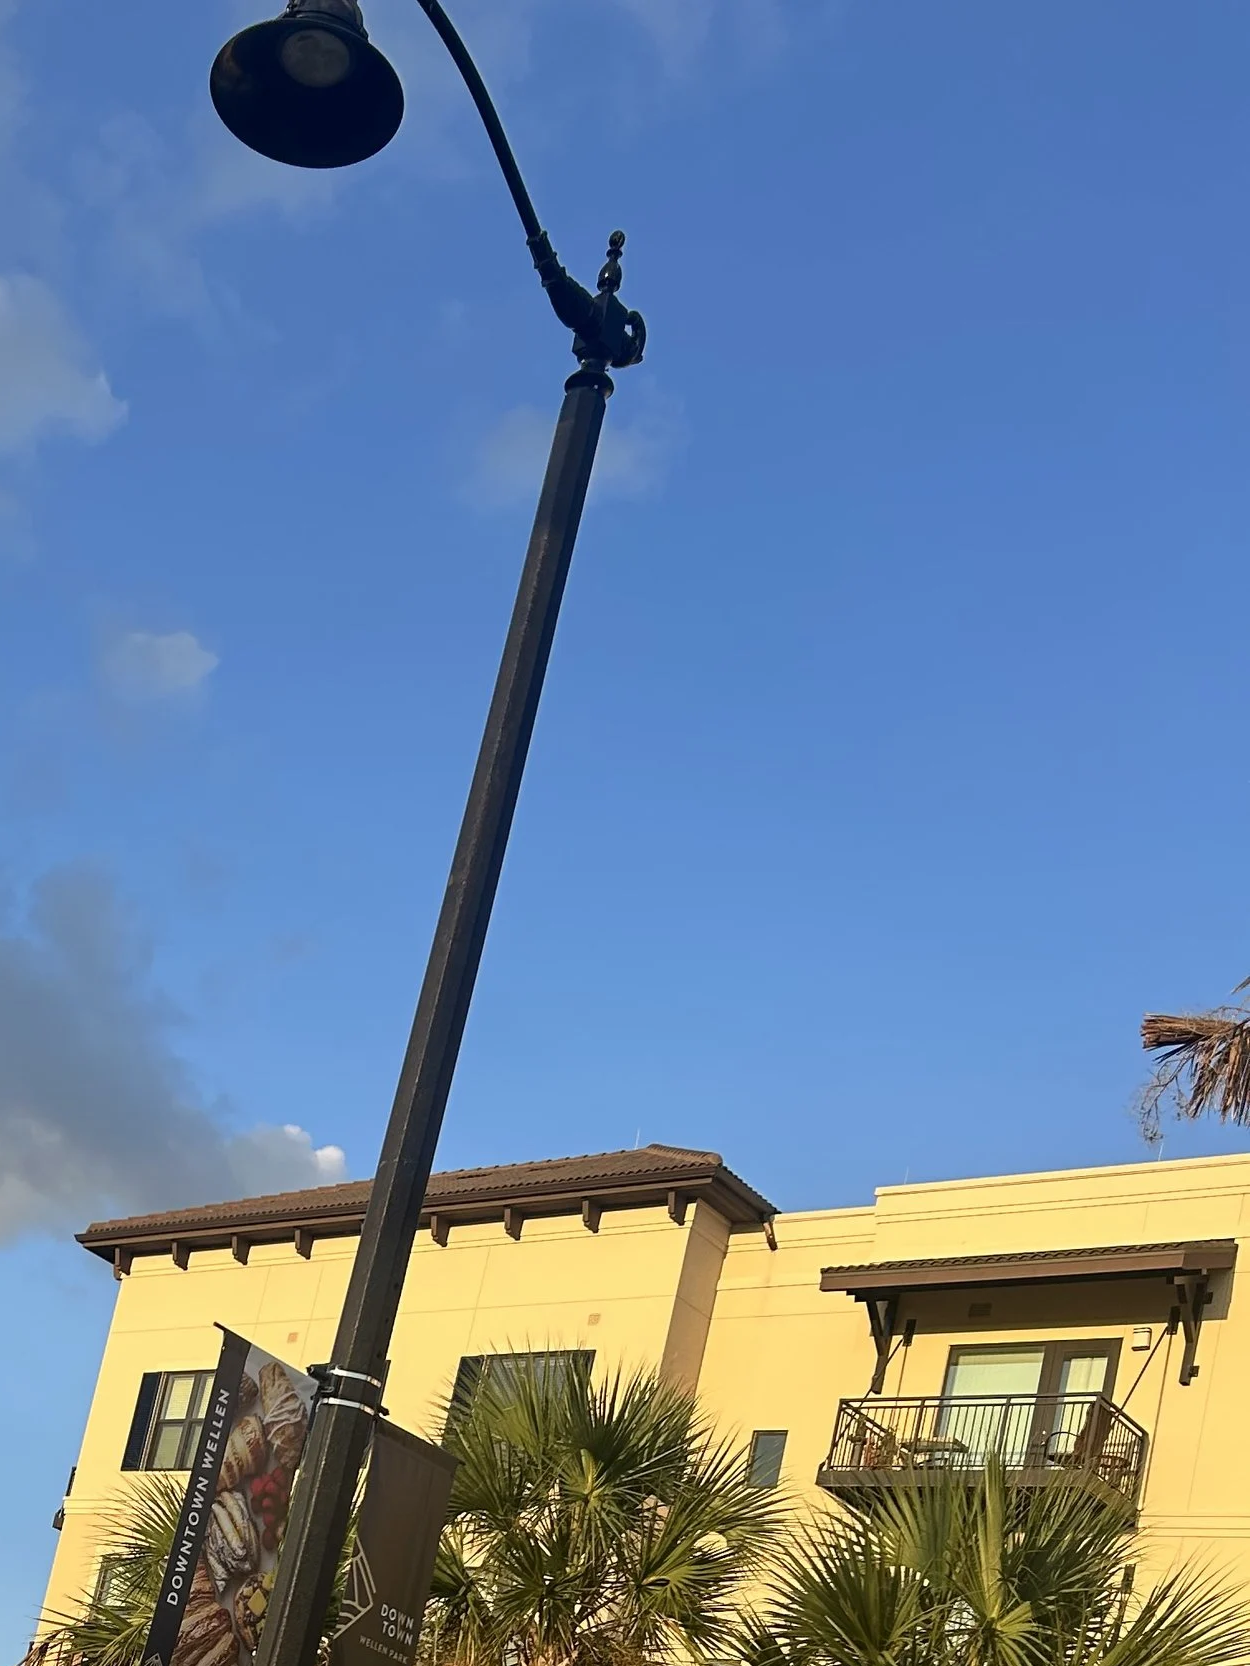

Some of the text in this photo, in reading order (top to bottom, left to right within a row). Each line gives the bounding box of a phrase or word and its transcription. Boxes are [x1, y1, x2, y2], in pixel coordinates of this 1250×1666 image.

[166, 1388, 230, 1606] DOWNTOWN WELLEN
[380, 1603, 414, 1630] DOWN
[382, 1620, 413, 1646] TOWN
[359, 1635, 408, 1665] WELLEN PARK
